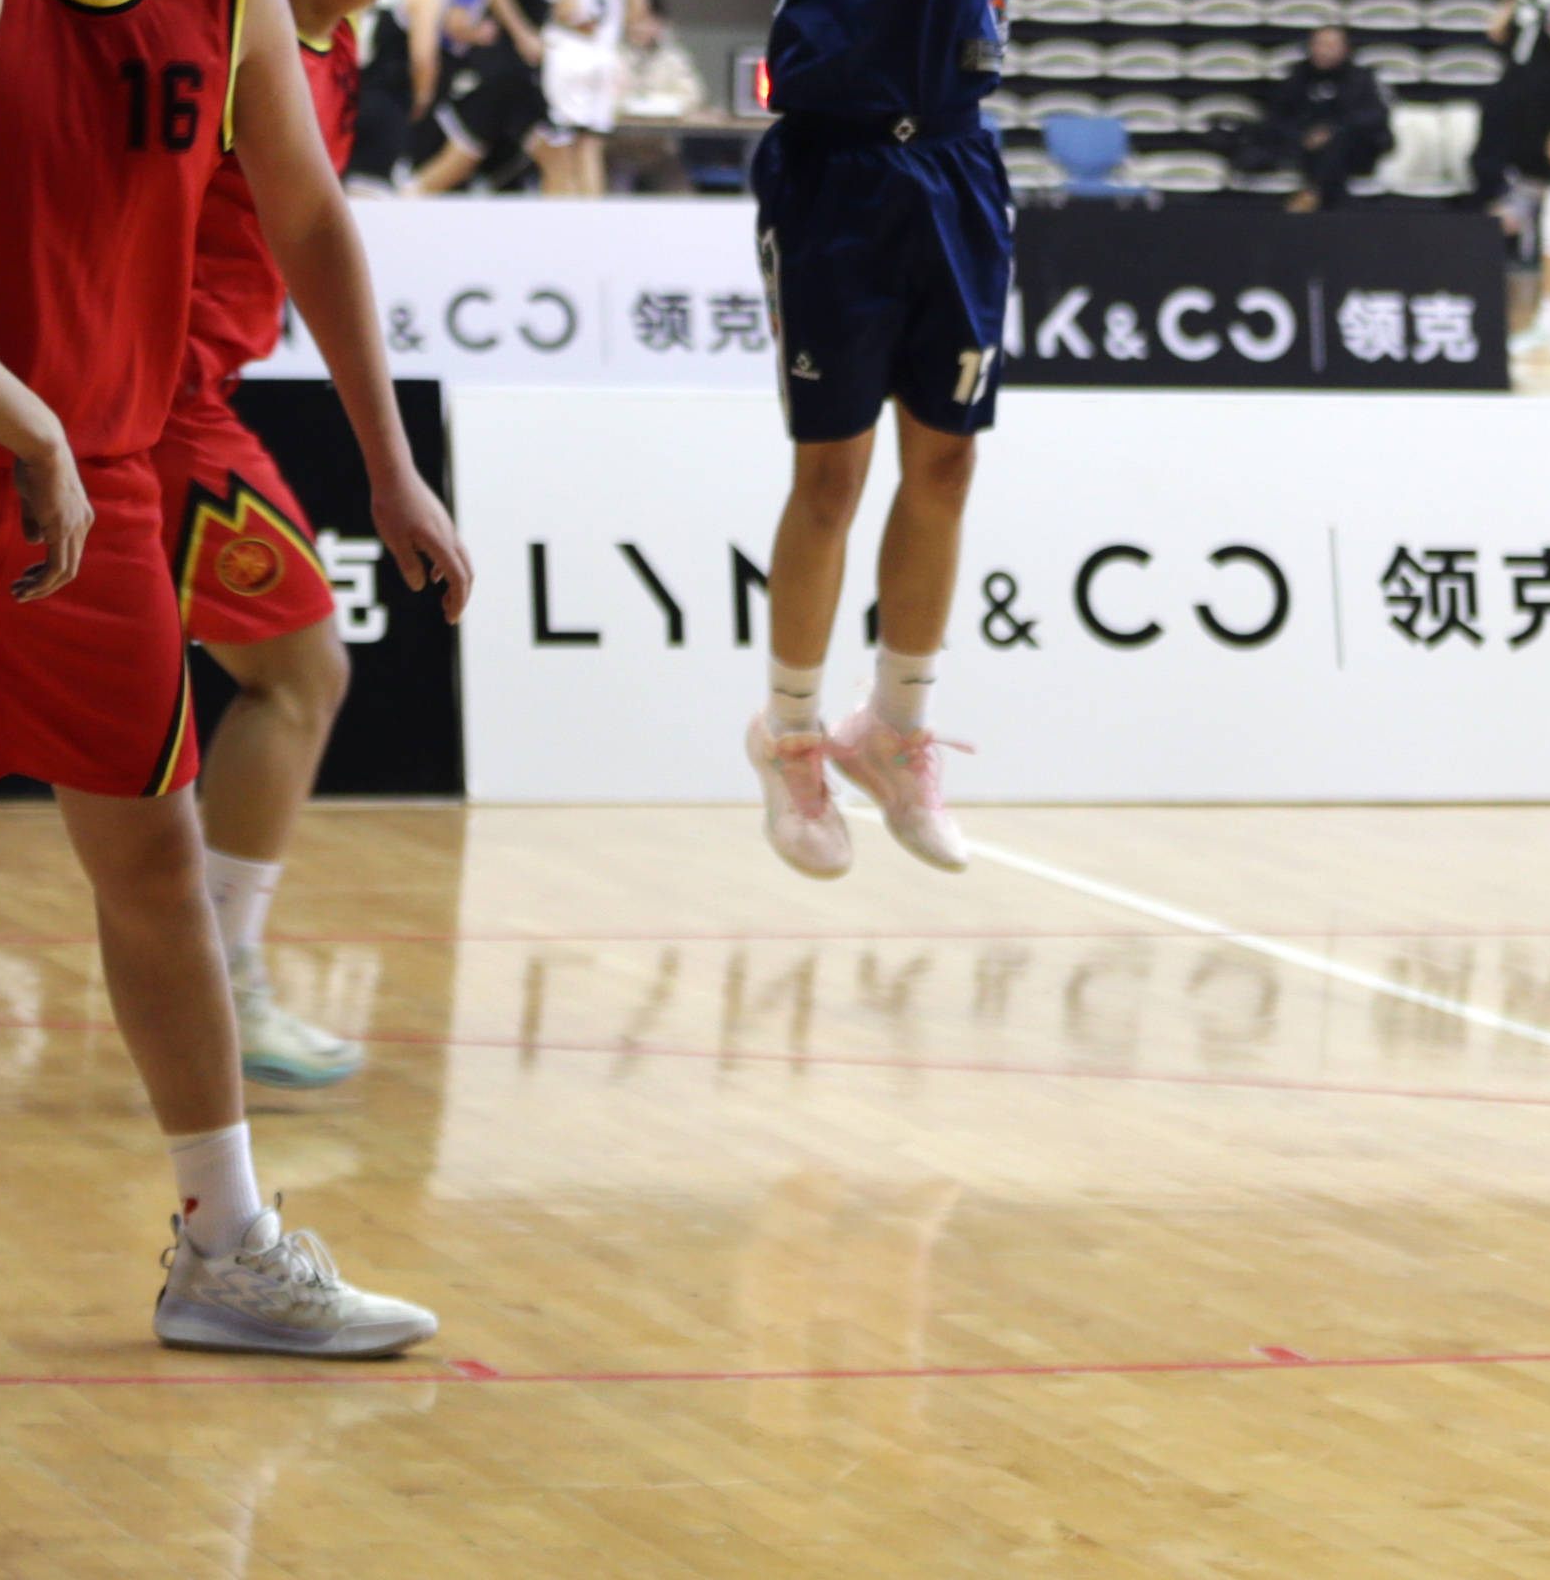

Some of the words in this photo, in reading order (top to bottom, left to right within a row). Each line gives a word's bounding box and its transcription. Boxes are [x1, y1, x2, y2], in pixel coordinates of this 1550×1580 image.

[119, 59, 205, 153] 16
[631, 290, 771, 353] 领克
[1337, 289, 1480, 365] 领克
